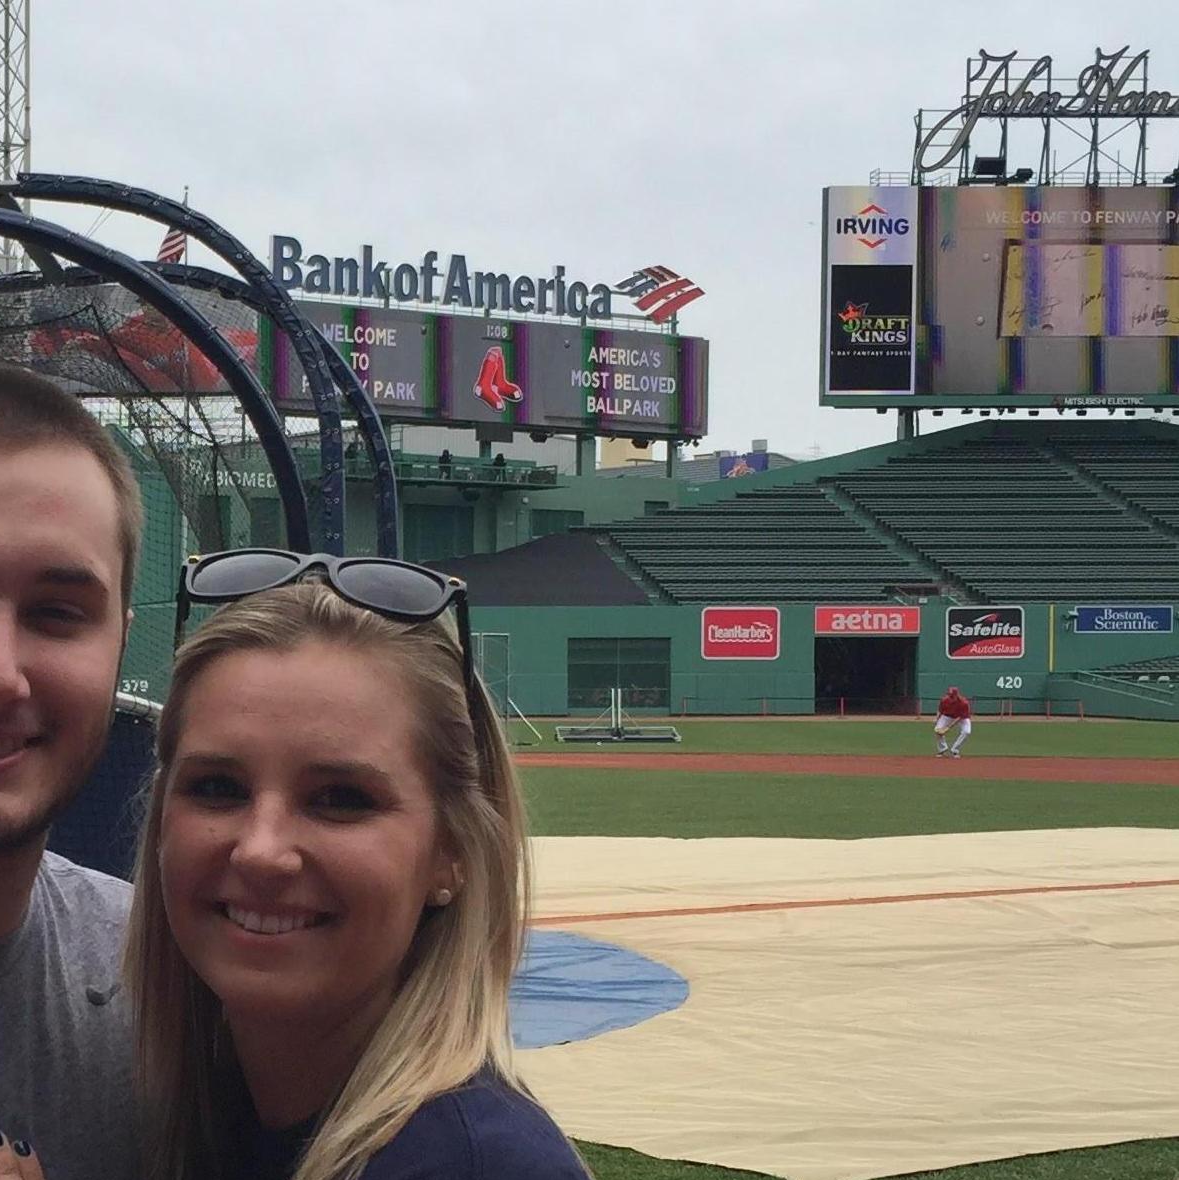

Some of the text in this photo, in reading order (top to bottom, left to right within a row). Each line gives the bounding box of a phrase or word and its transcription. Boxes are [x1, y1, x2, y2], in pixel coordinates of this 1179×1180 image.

[915, 48, 1062, 172] John
[986, 210, 1068, 224] WELCOME
[1072, 210, 1092, 224] TO
[1095, 210, 1162, 225] FENWAY
[836, 218, 910, 235] IRVING
[271, 234, 613, 320] Bank of America
[843, 317, 909, 333] DRAFT
[322, 323, 397, 347] WELCOME
[850, 330, 907, 343] KINGS
[350, 352, 369, 371] TO
[587, 346, 661, 368] AMERICA'S
[571, 368, 676, 394] MOST BELOVED
[373, 380, 416, 400] PARK
[586, 396, 660, 417] BALLPARK
[1107, 397, 1145, 405] ELECTRIC
[831, 610, 903, 631] aetna
[1104, 608, 1144, 621] Boston
[950, 622, 1020, 637] Safelite
[1095, 616, 1159, 631] Scientific
[969, 643, 1021, 656] AutoGlass
[996, 676, 1021, 689] 420
